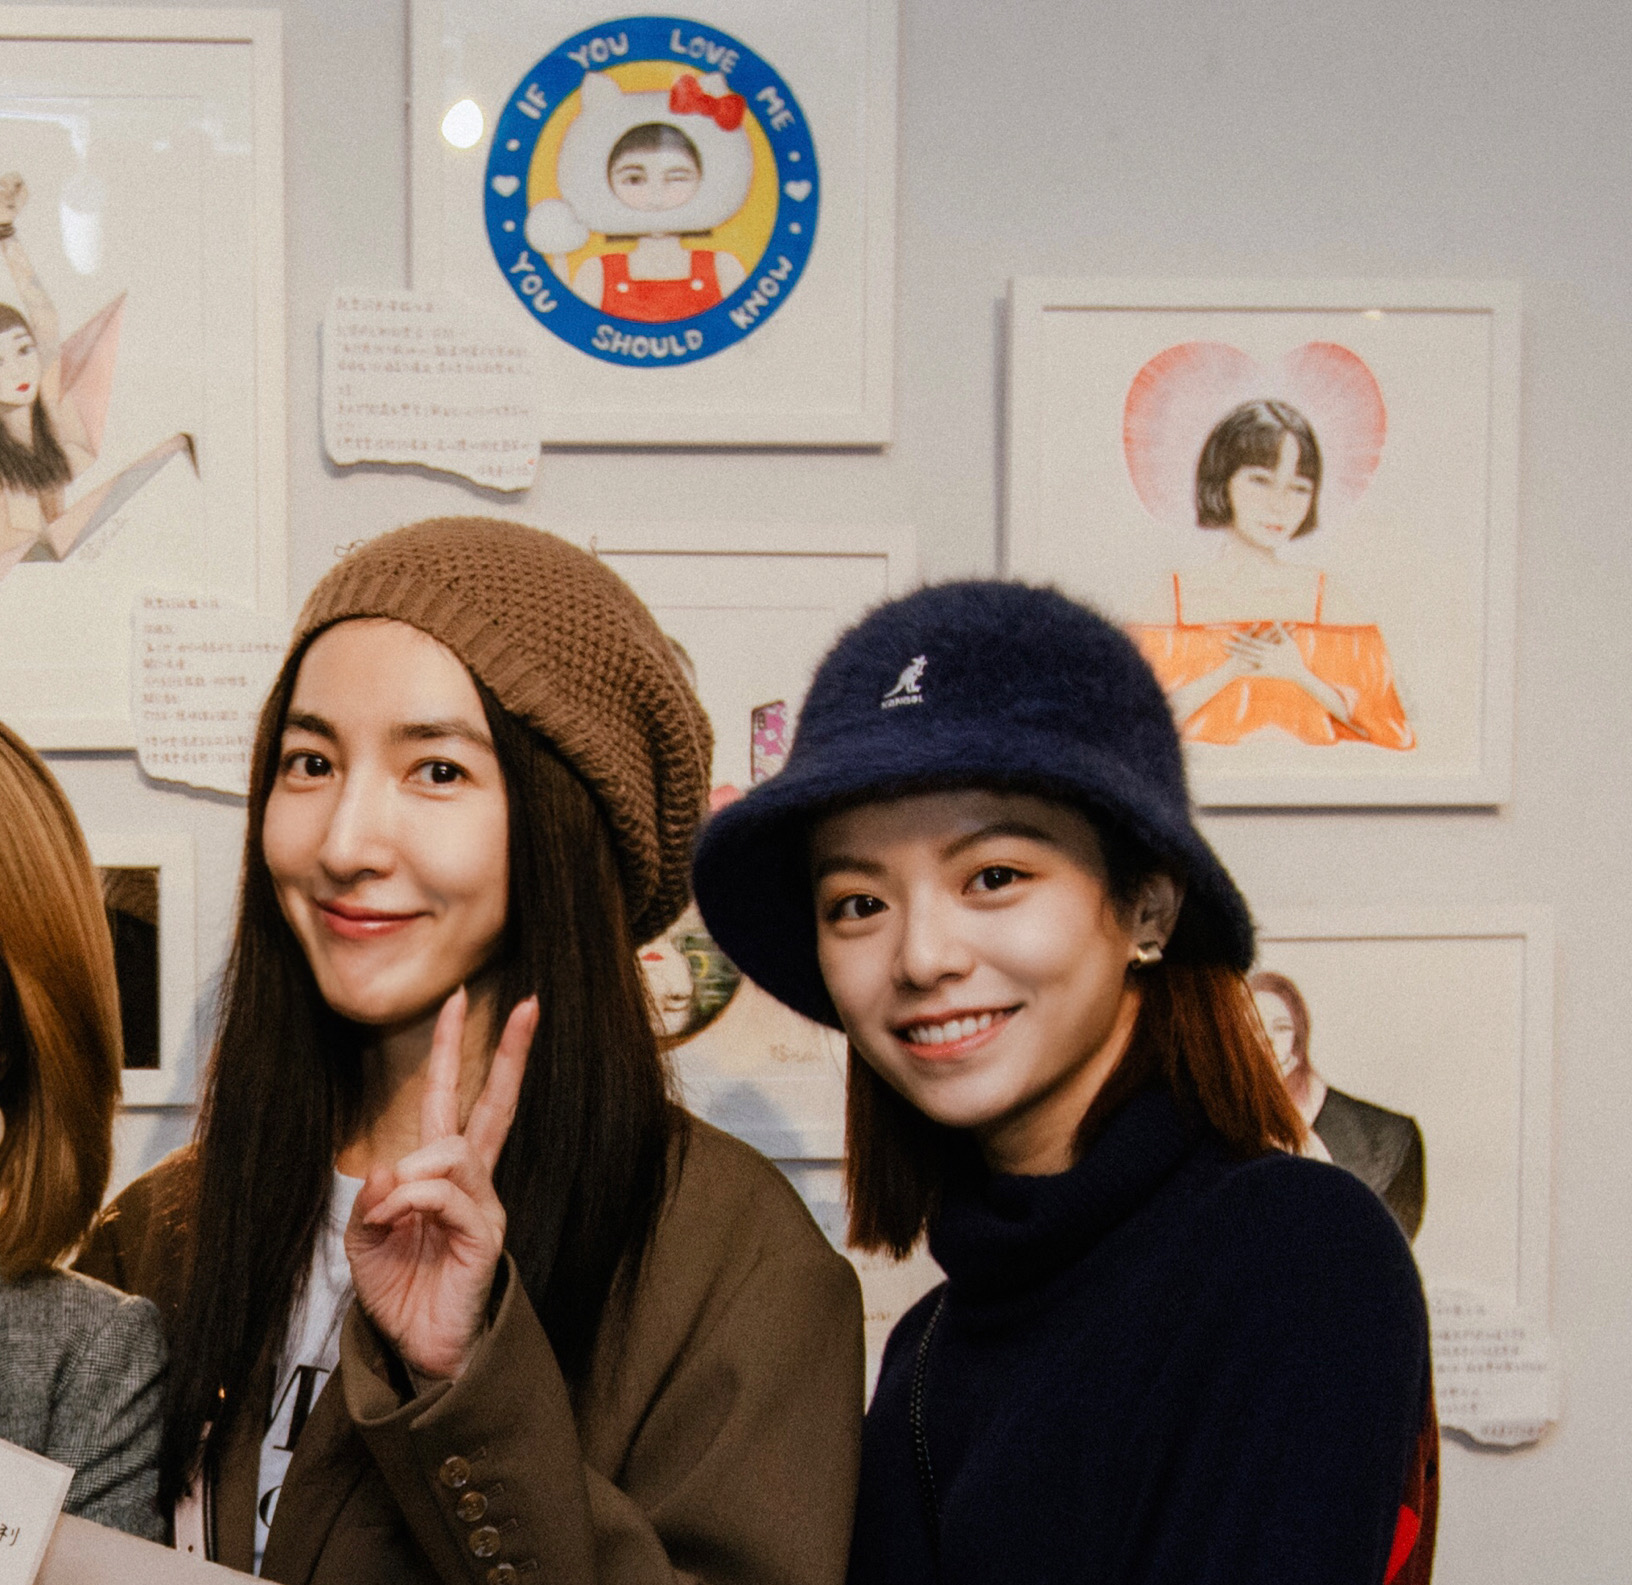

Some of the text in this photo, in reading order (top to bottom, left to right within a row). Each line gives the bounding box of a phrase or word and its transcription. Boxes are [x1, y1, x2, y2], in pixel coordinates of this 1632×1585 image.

[516, 28, 795, 132] IF YOU LOVE ME
[509, 250, 558, 314] YOU
[591, 324, 704, 359] SHOULD
[728, 255, 793, 330] KNOW
